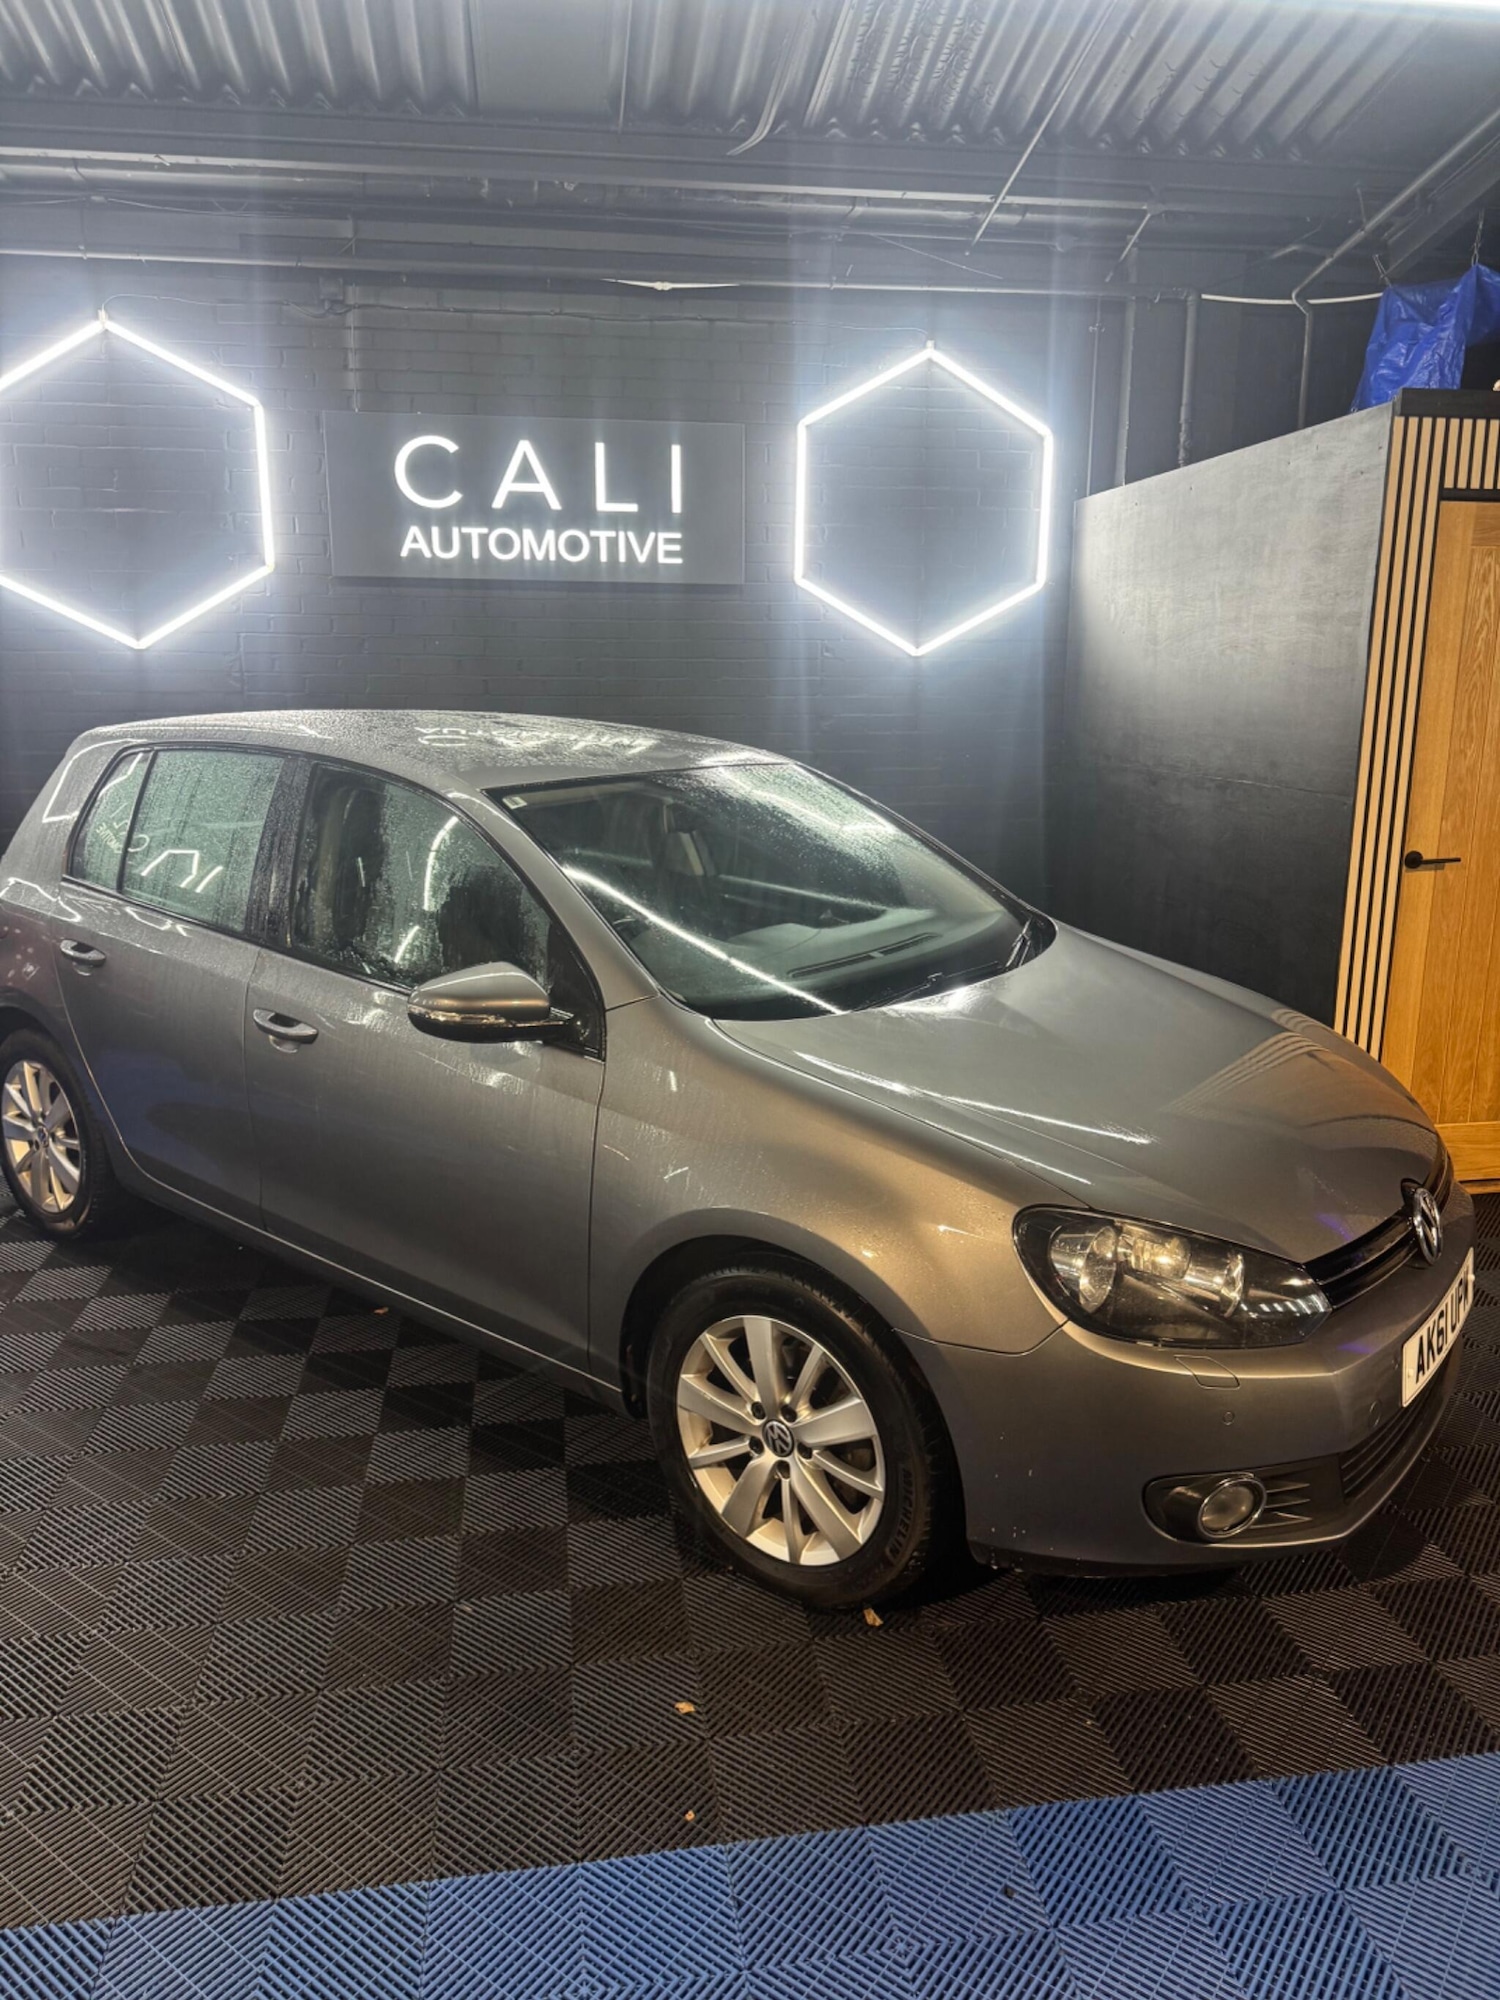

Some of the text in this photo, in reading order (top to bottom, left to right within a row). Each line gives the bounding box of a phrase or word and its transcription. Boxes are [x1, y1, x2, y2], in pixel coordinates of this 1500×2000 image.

[394, 435, 682, 514] CALI
[400, 525, 683, 565] AUTOMOTIVE
[1415, 1303, 1448, 1385] AK61
